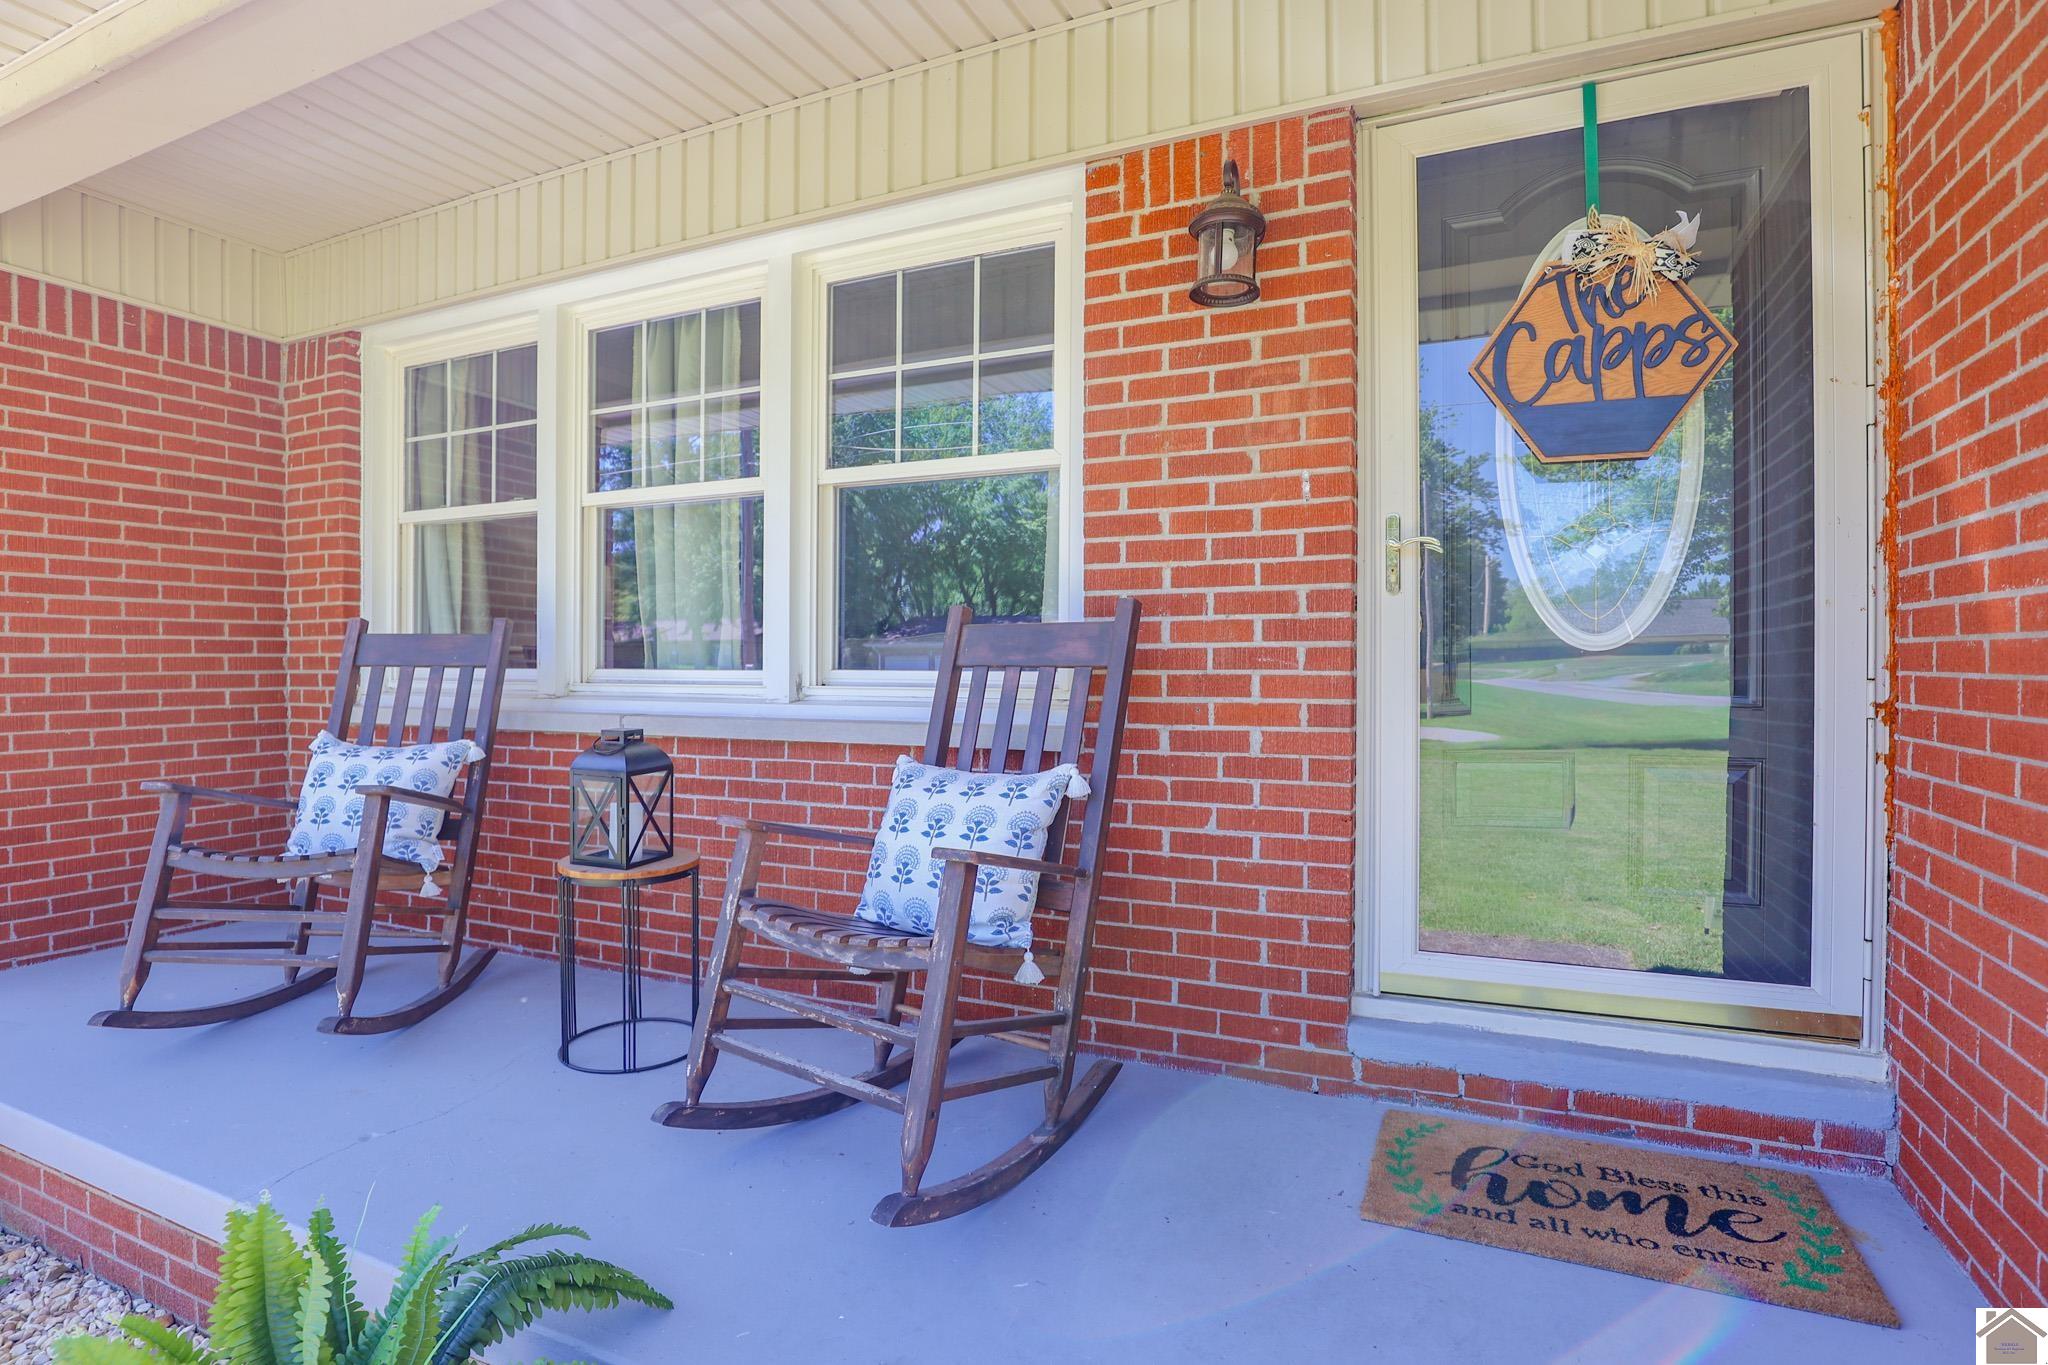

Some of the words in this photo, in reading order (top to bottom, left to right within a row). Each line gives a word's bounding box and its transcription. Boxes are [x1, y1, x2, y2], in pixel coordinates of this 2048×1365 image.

[1536, 264, 1647, 335] The
[1492, 313, 1718, 407] Capps
[1435, 1146, 1788, 1244] home
[1512, 1154, 1583, 1177] God
[1595, 1166, 1689, 1193] Bless
[1699, 1184, 1768, 1208] this
[1451, 1203, 1516, 1225] and
[1529, 1216, 1570, 1235] all
[1581, 1226, 1660, 1250] who
[1673, 1245, 1775, 1273] enter
